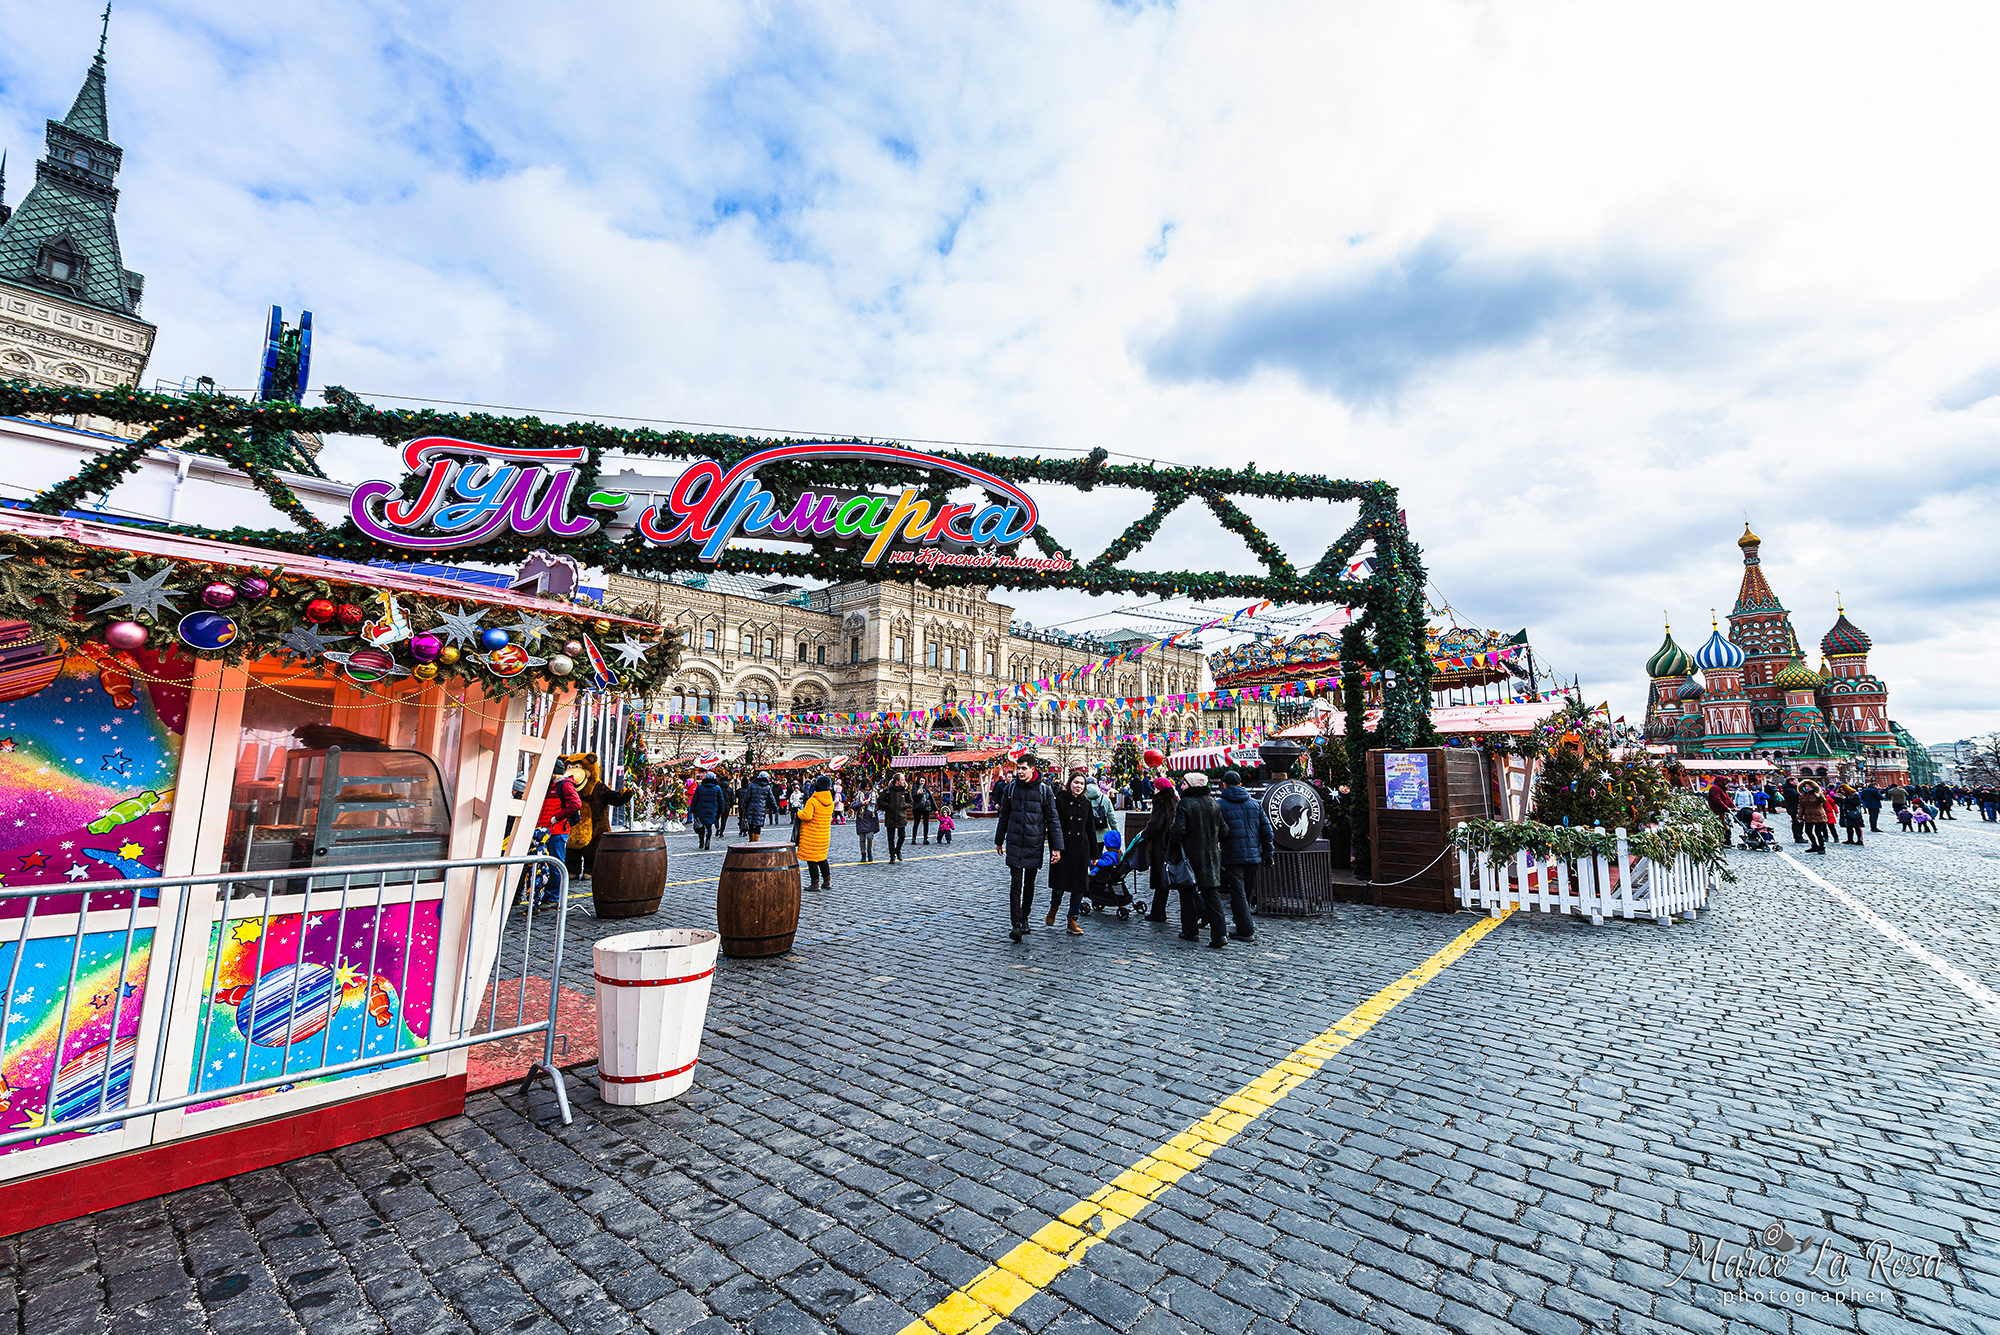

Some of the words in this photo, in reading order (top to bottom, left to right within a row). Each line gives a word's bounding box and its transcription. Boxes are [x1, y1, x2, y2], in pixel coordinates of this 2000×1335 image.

[889, 549, 915, 563] на
[916, 548, 995, 569] Красной
[997, 552, 1073, 572] площади
[1270, 785, 1292, 825] ЖАРЕНЫЕ
[1294, 785, 1320, 822] КАШТАНЫ
